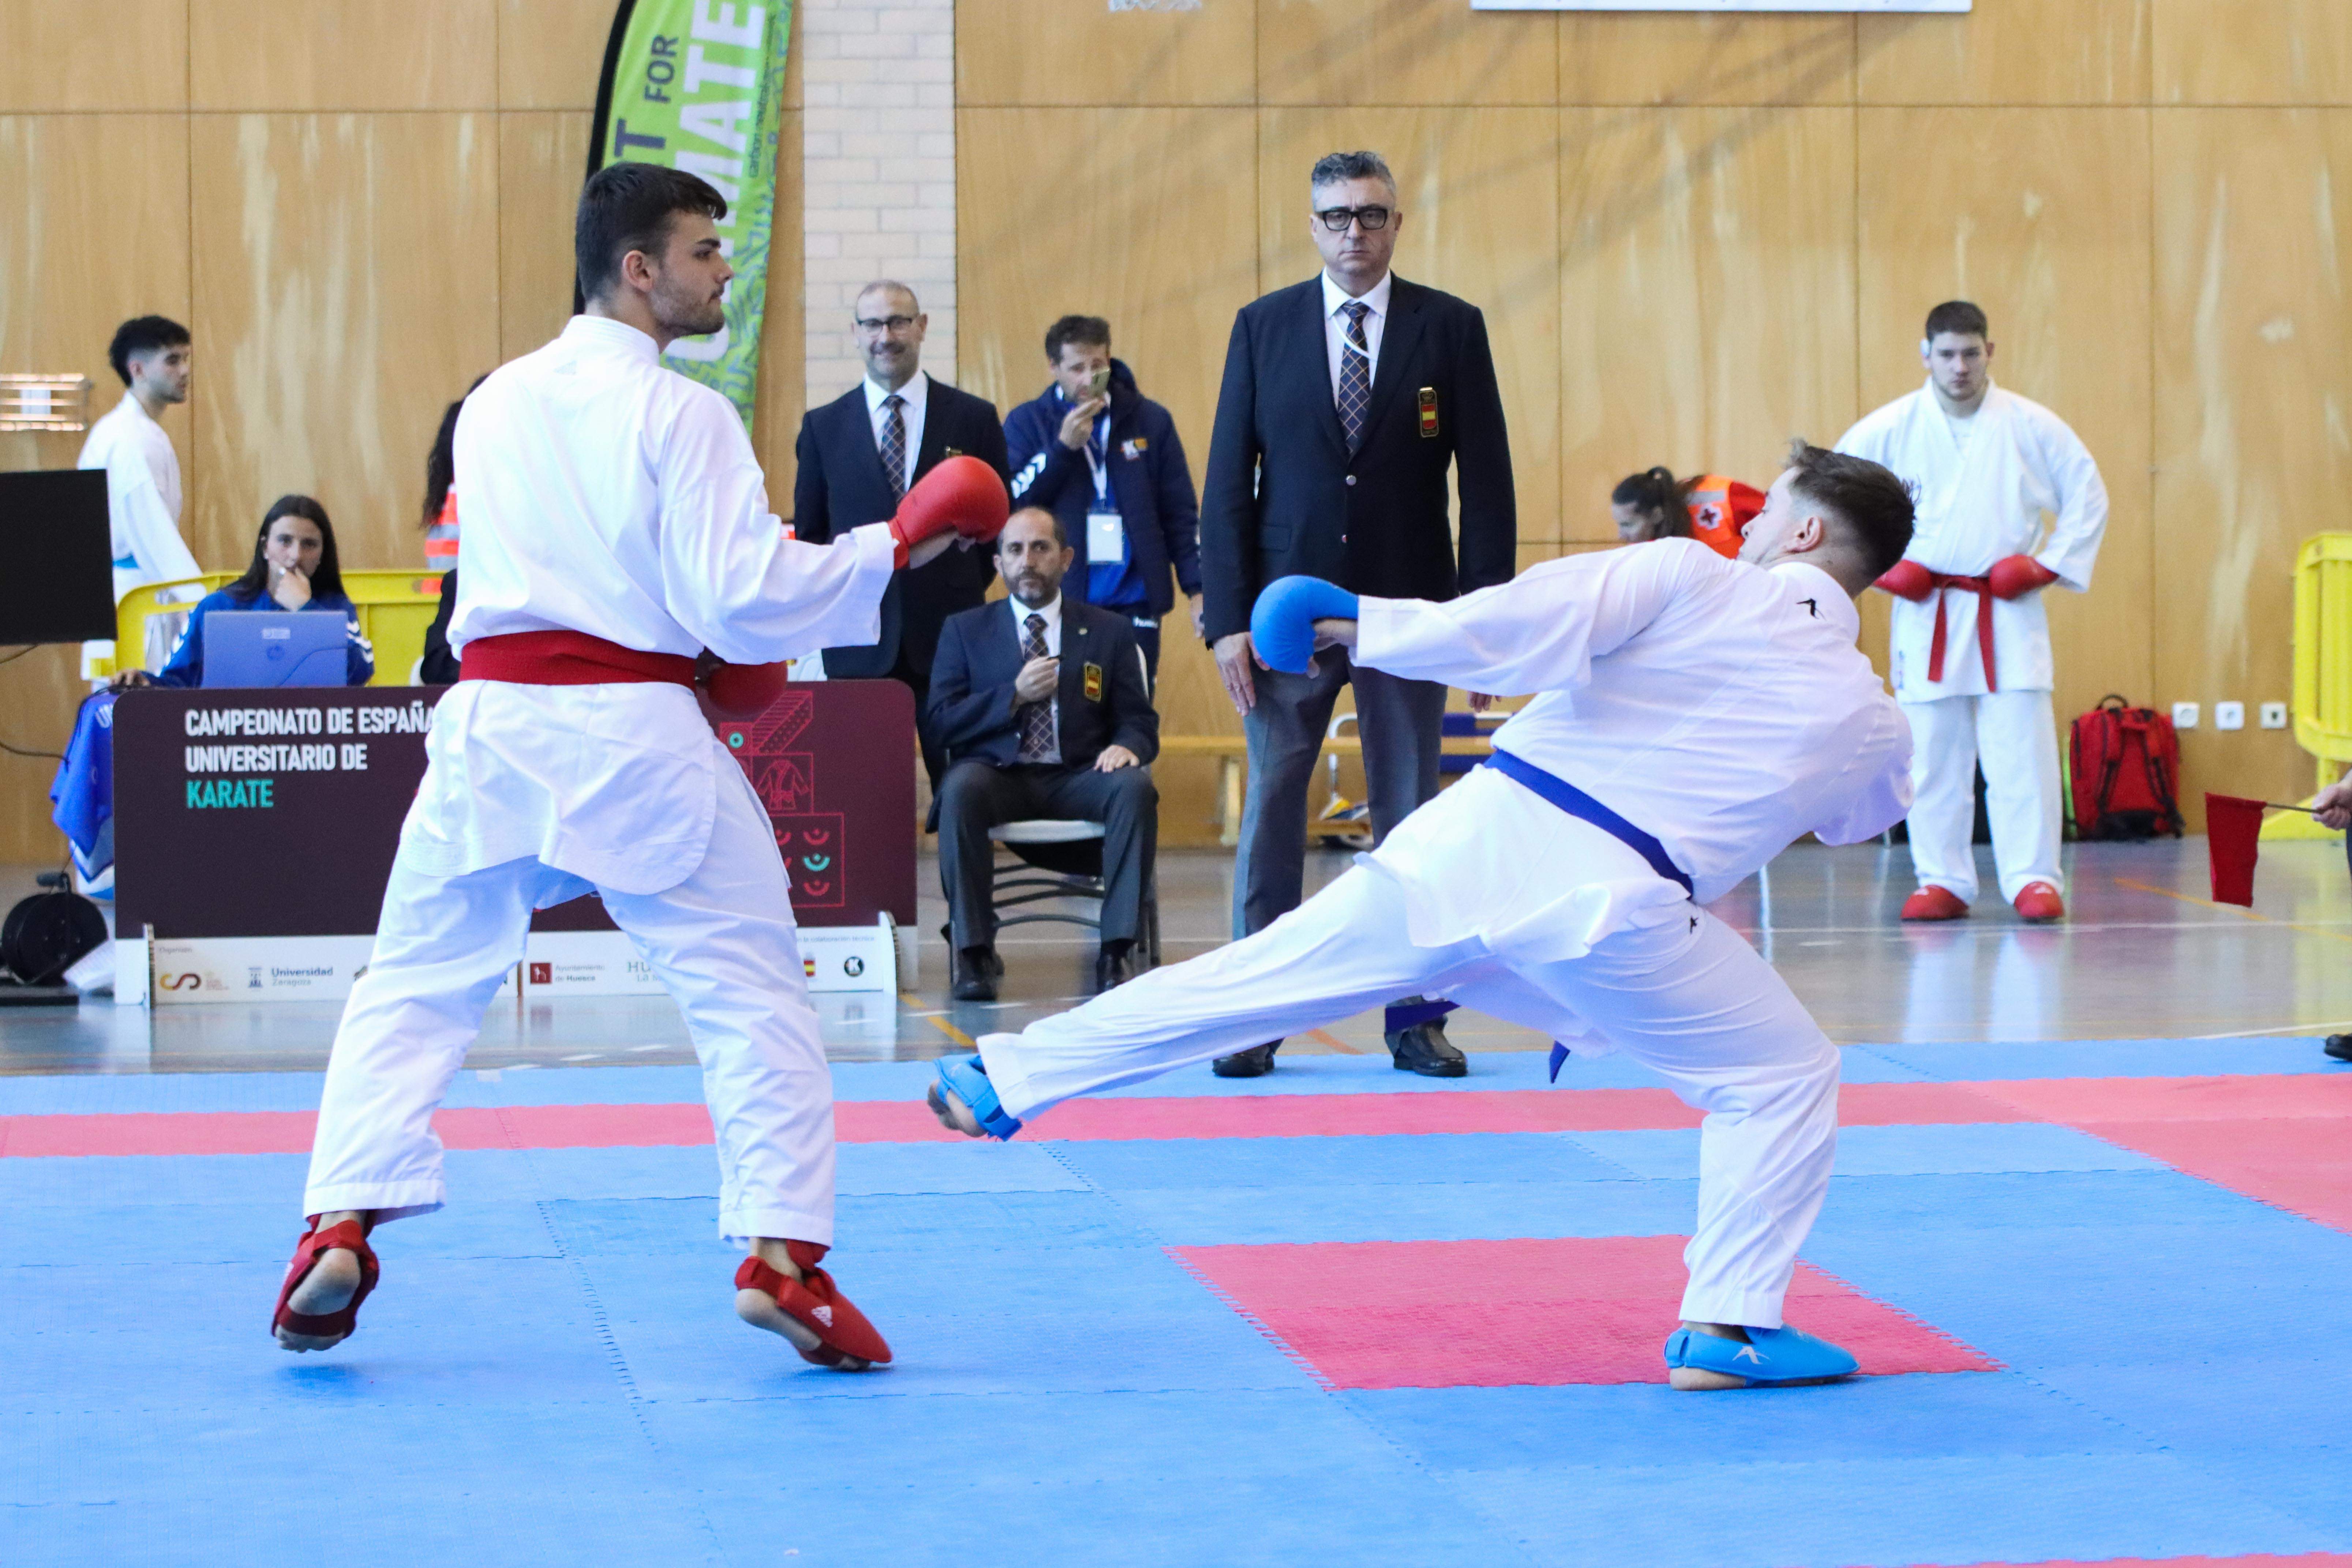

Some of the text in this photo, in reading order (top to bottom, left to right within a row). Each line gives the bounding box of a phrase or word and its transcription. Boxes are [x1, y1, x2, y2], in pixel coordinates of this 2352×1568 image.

[644, 34, 678, 104] FOR
[185, 708, 321, 737] CAMPEONATO
[327, 707, 353, 734] DE
[185, 744, 367, 772] UNIVERSITARIO DE
[186, 779, 274, 808] KARATE
[272, 967, 333, 977] Universidad
[272, 978, 311, 987] Zaragoza
